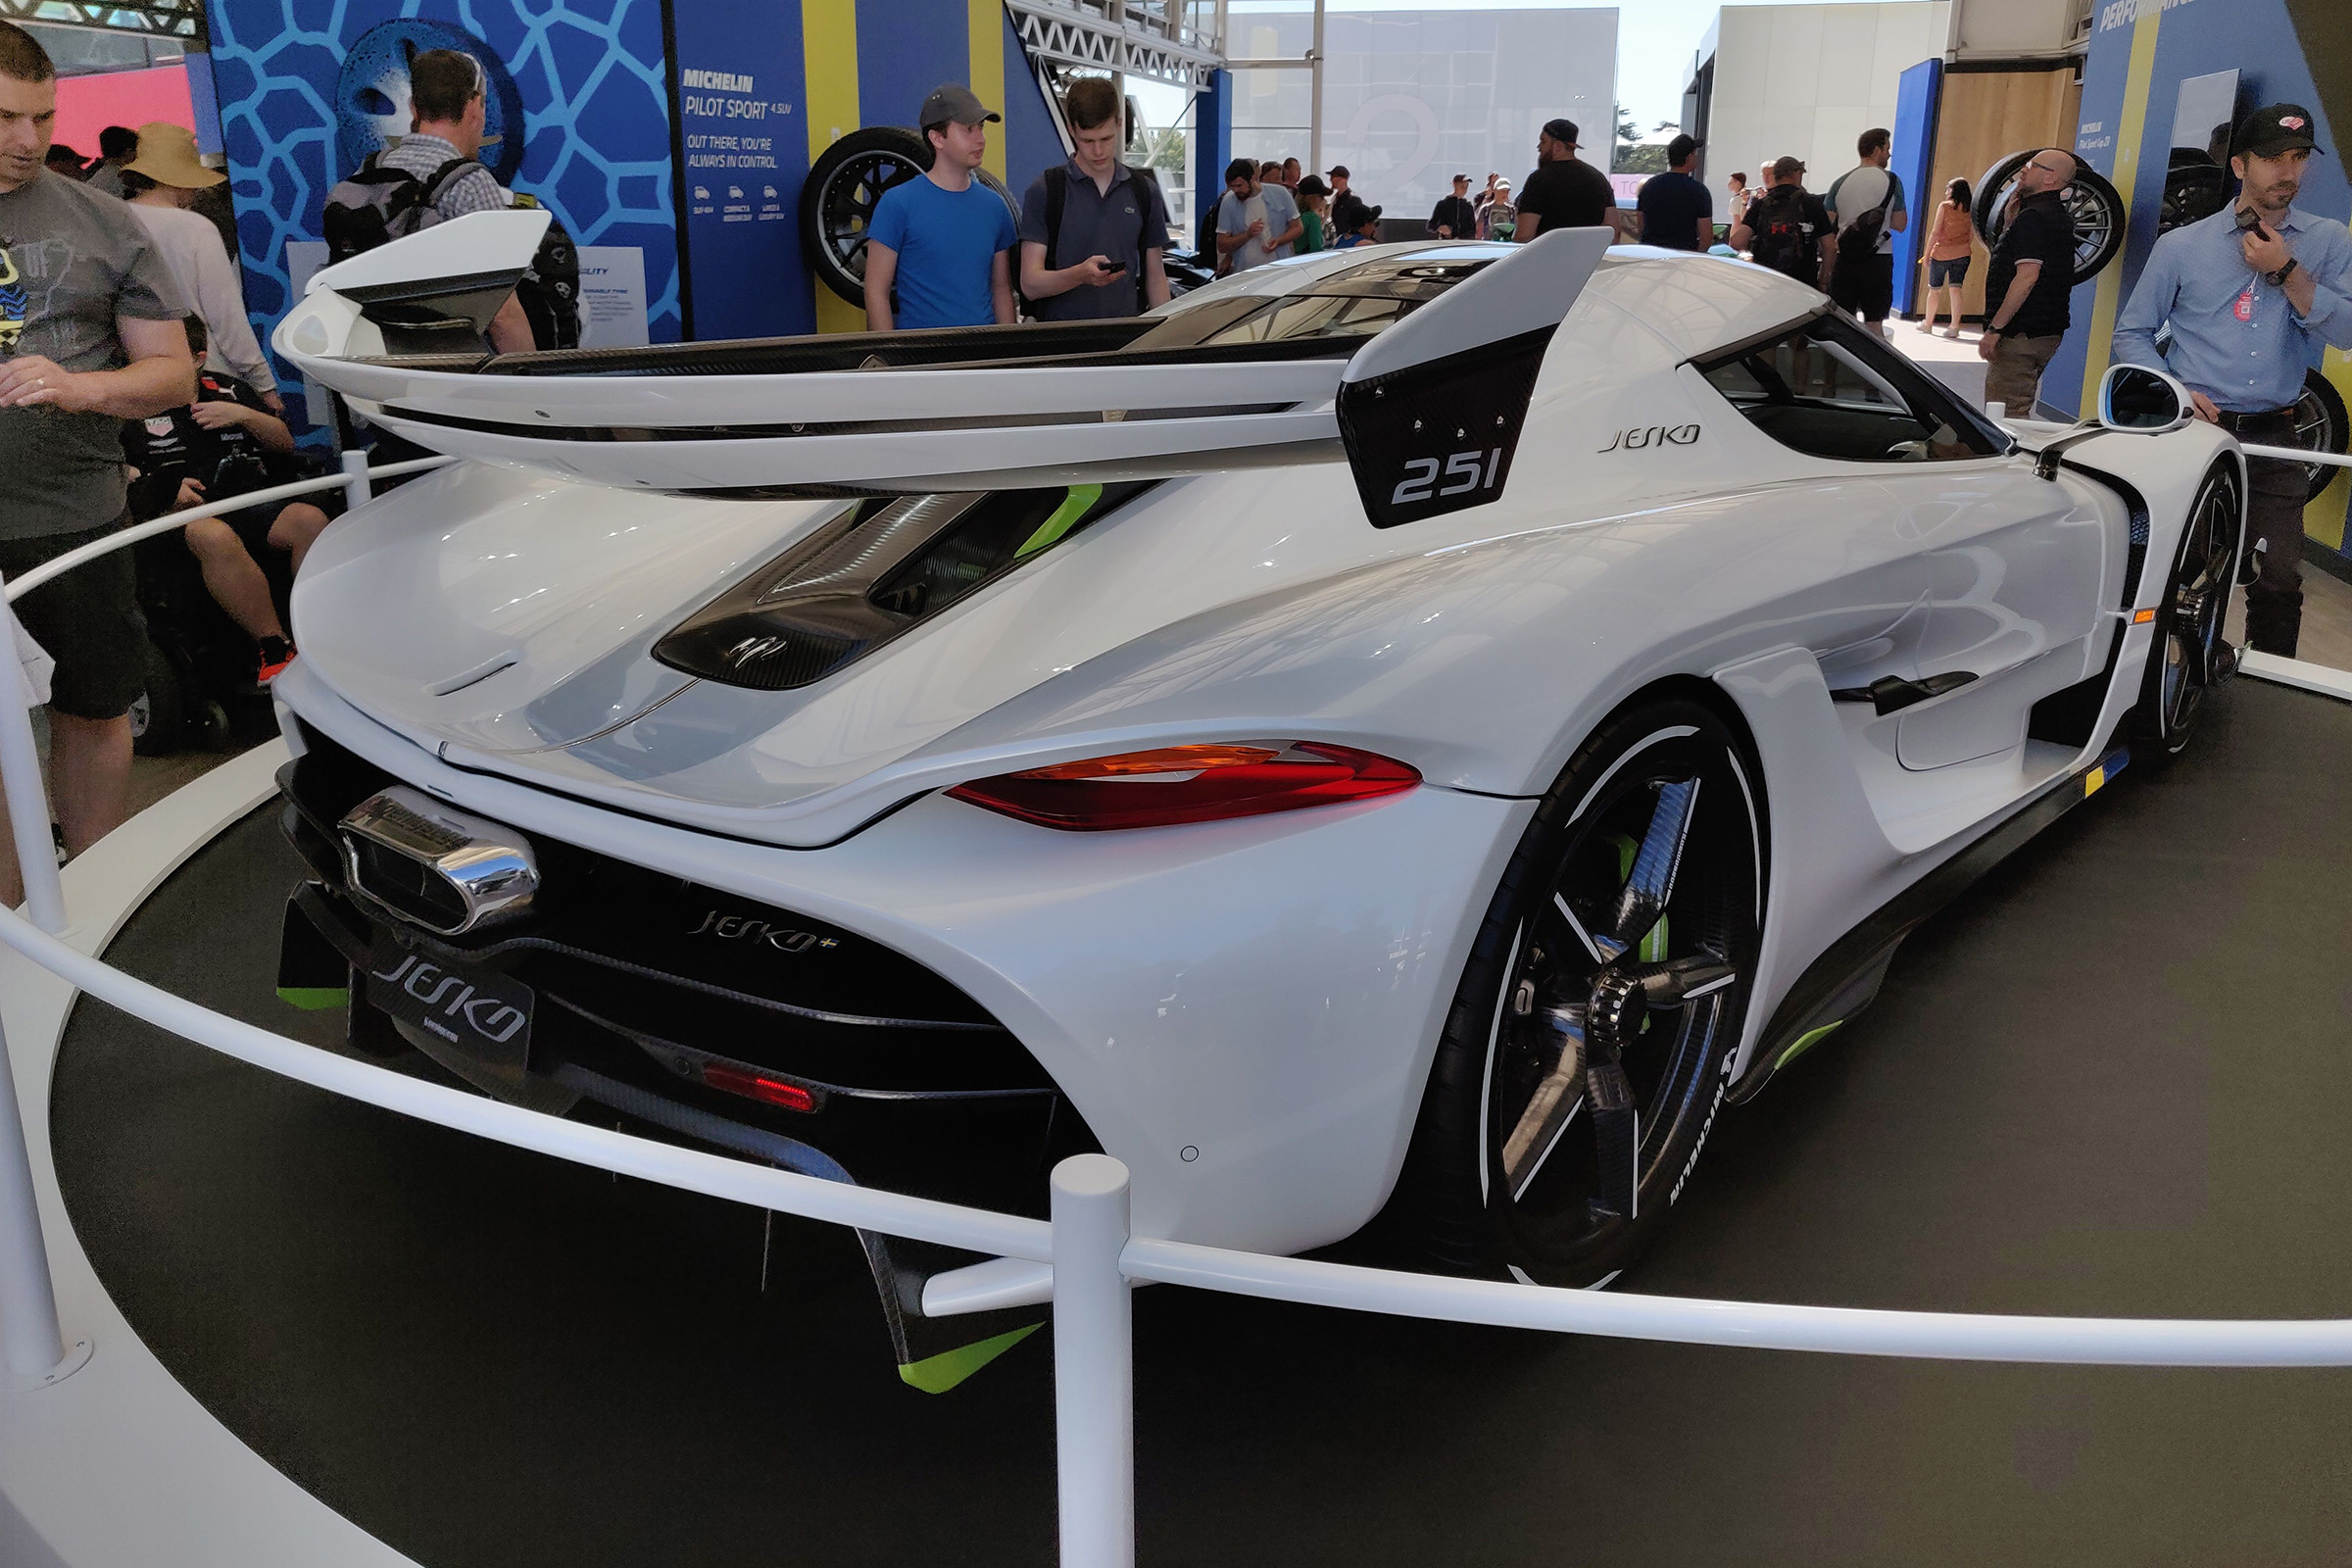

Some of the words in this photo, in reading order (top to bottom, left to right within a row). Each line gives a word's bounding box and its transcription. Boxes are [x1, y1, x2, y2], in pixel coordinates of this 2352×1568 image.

[683, 69, 754, 93] MICHELIN
[685, 95, 724, 117] PILOT
[726, 99, 767, 120] SPORT
[687, 133, 708, 149] OUT
[709, 134, 740, 151] THERE,
[741, 137, 772, 151] YOU'RE
[688, 154, 725, 168] ALWAYS
[726, 155, 738, 168] IN
[1596, 422, 1701, 454] JESKO
[1391, 447, 1502, 505] 251
[686, 909, 817, 954] JESKO
[371, 955, 526, 1044] JESKO
[1669, 1081, 1725, 1207] MICHELIN
